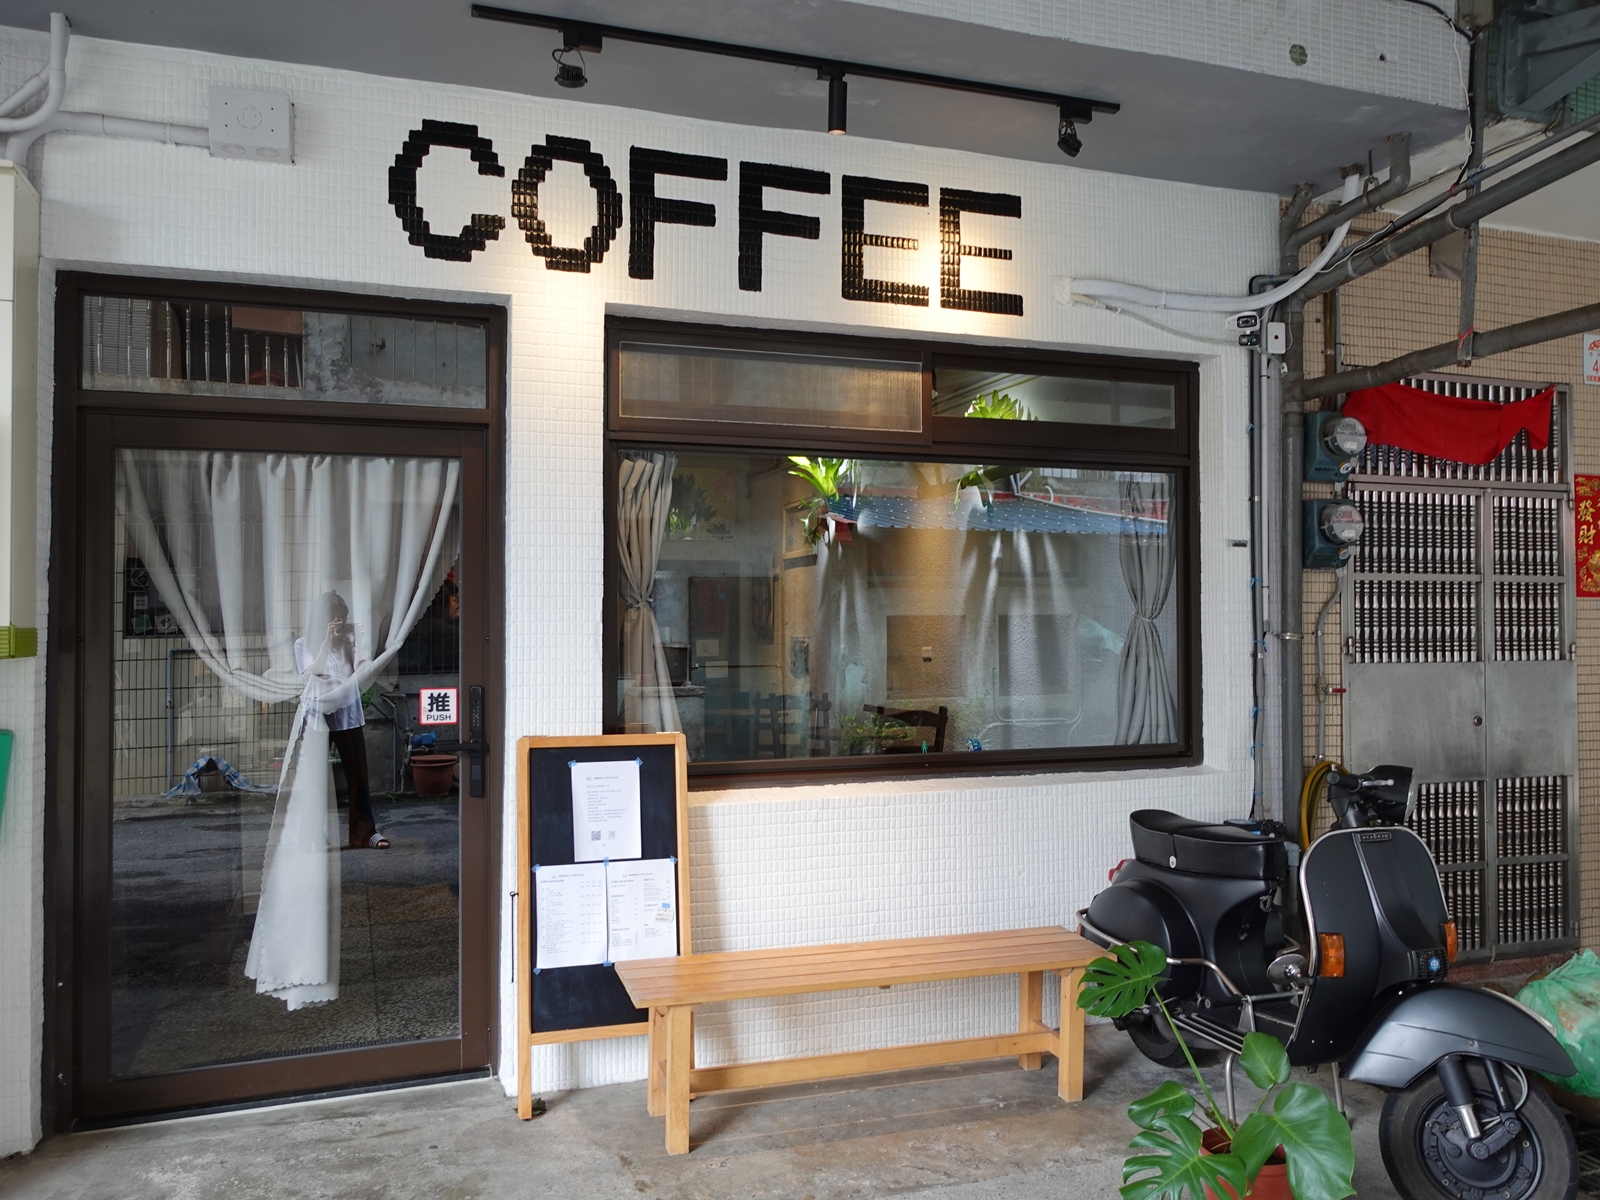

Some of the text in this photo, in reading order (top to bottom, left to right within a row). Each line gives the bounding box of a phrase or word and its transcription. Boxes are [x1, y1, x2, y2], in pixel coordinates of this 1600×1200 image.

[388, 119, 1024, 316] COFFEE
[1577, 499, 1597, 545] 發財
[427, 692, 451, 712] 推
